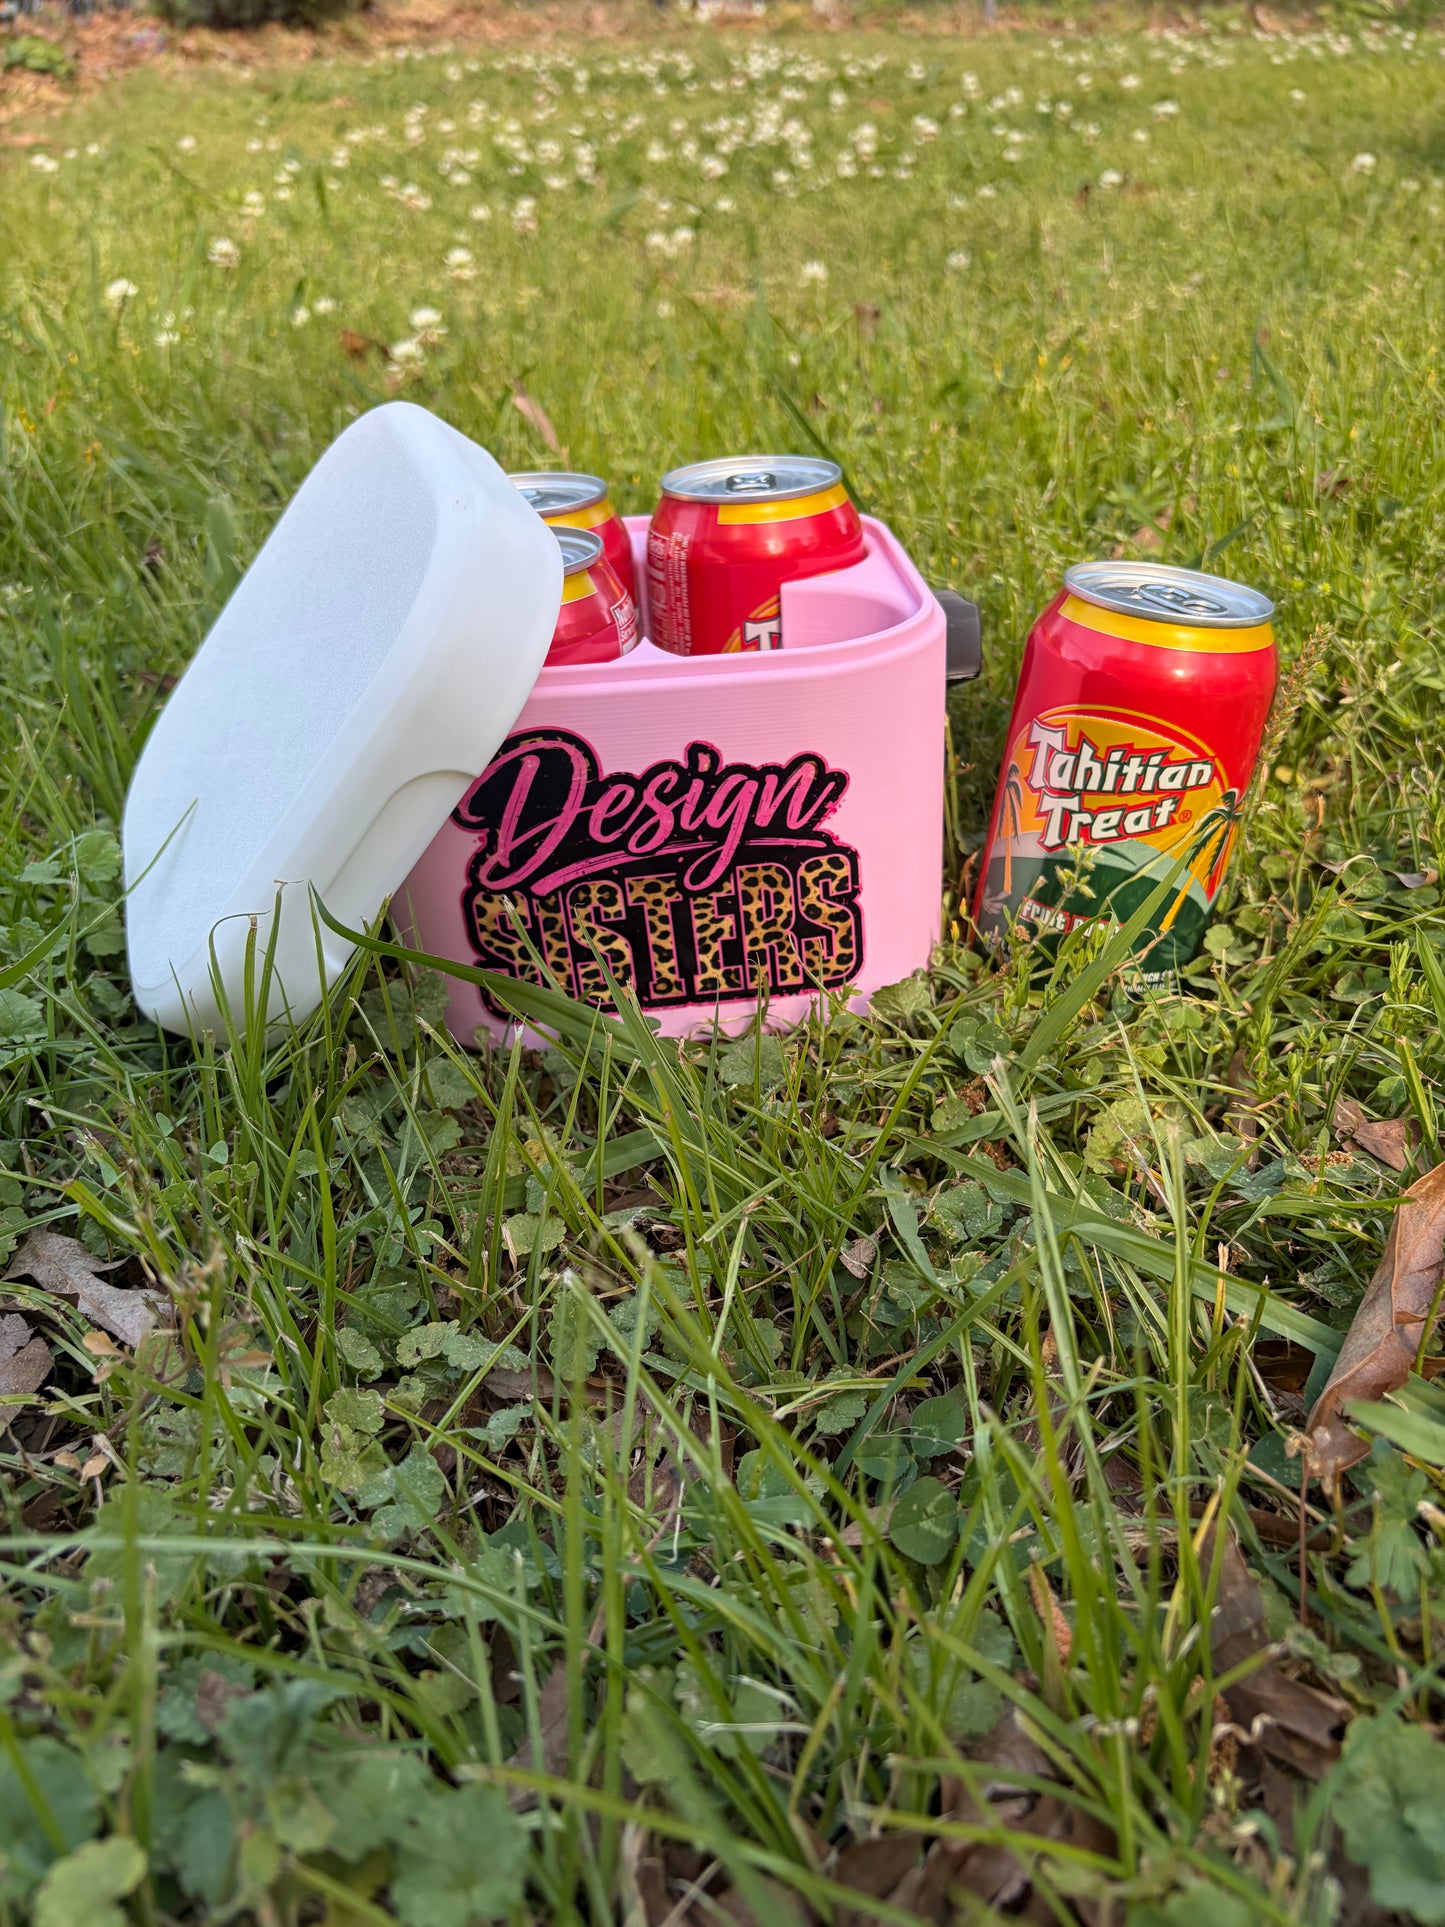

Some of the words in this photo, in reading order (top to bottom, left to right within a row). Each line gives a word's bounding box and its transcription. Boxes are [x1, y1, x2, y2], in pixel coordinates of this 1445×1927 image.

[1029, 718, 1214, 794] Tahitian
[458, 738, 835, 892] Design
[1039, 793, 1178, 850] Treat
[472, 852, 856, 1008] SISTERS
